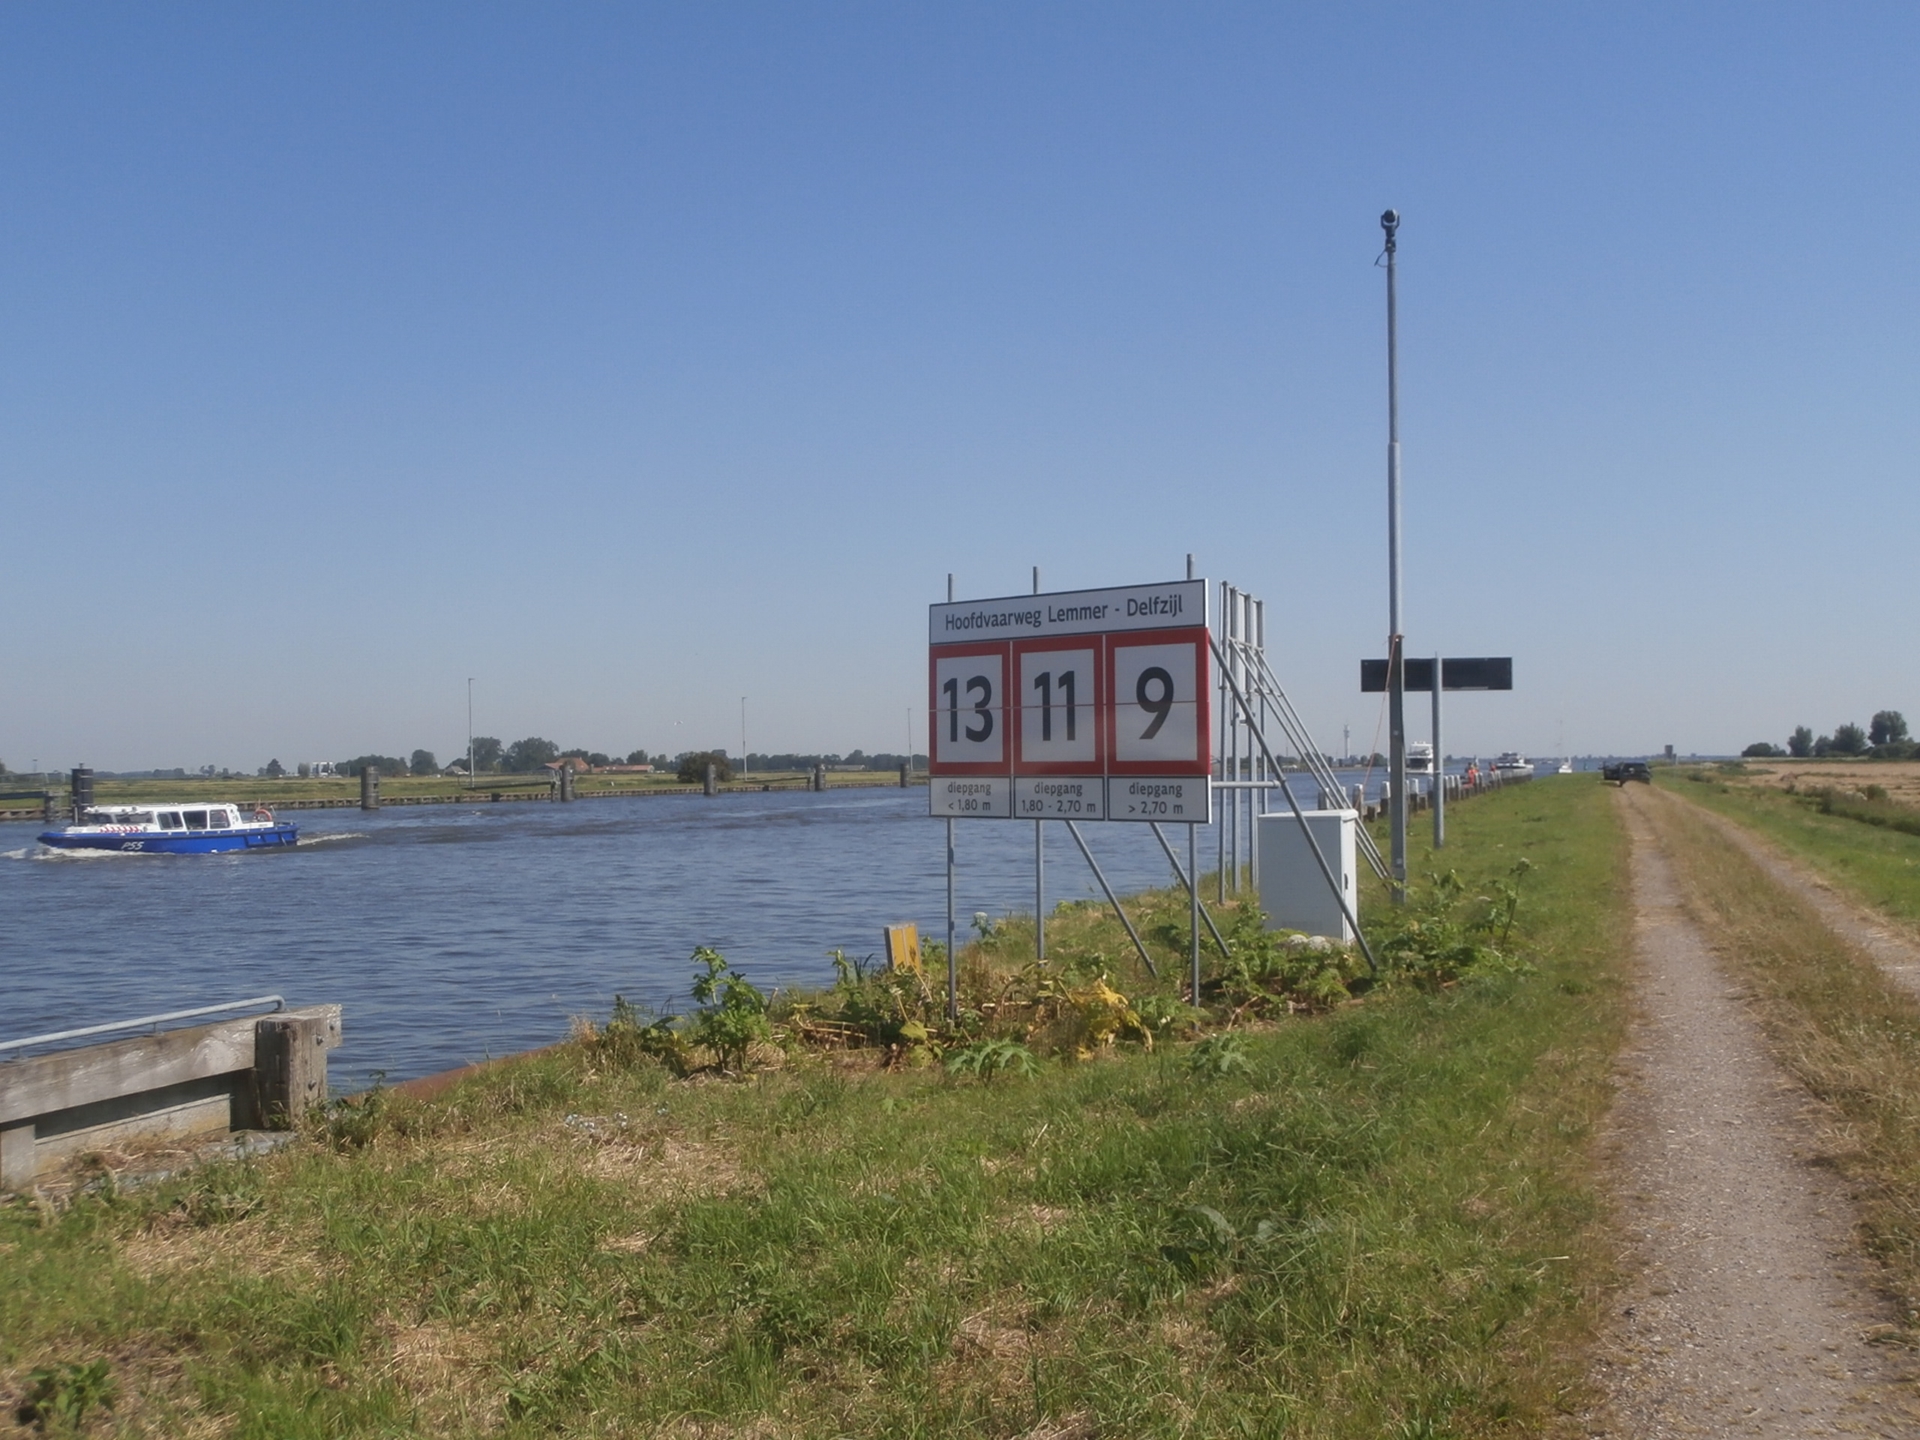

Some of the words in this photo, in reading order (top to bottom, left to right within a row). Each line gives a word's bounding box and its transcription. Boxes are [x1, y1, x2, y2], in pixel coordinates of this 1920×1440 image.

[945, 608, 1042, 631] Hoofdvaarweg
[1048, 604, 1109, 623] Lemmer
[1126, 594, 1183, 617] Delfzijl
[943, 675, 994, 743] 13
[1034, 670, 1076, 742] 11
[1136, 666, 1175, 740] 9
[947, 781, 992, 796] diepgang
[1034, 782, 1083, 797] diepgang
[1129, 782, 1183, 798] diepgang
[957, 799, 978, 812] 1,80
[982, 802, 991, 811] m
[1022, 800, 1044, 813] 1,80
[1057, 800, 1082, 814] 2,70
[1086, 803, 1096, 813] m
[1141, 801, 1168, 816] 2,70
[1173, 804, 1184, 815] m
